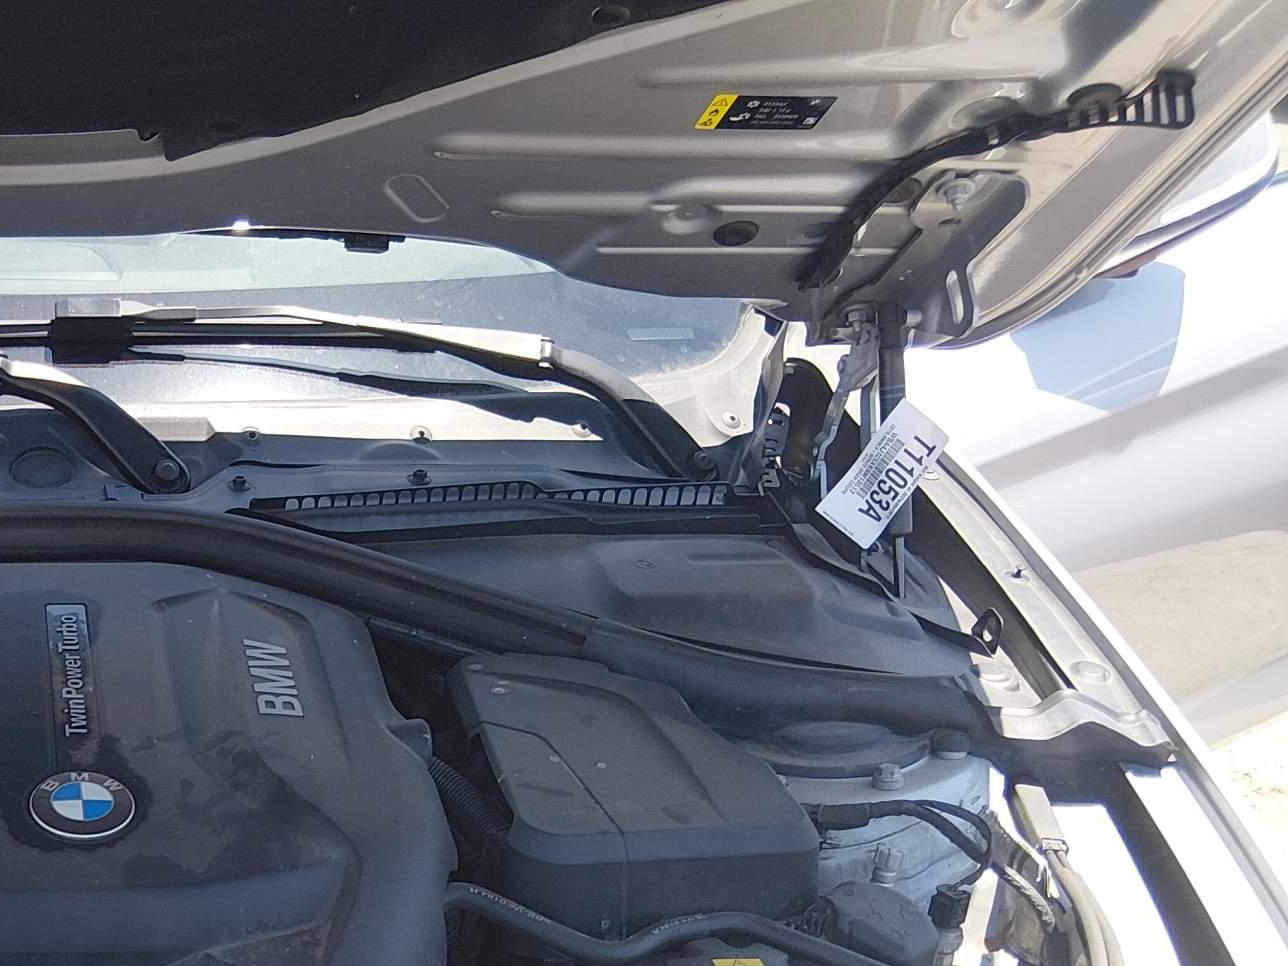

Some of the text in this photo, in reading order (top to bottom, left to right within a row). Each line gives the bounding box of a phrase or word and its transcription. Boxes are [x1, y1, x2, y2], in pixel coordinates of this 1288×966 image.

[857, 435, 936, 522] T11053A
[57, 614, 89, 737] TwinPower Turbo
[242, 638, 305, 718] BMW
[39, 772, 123, 792] BMW
